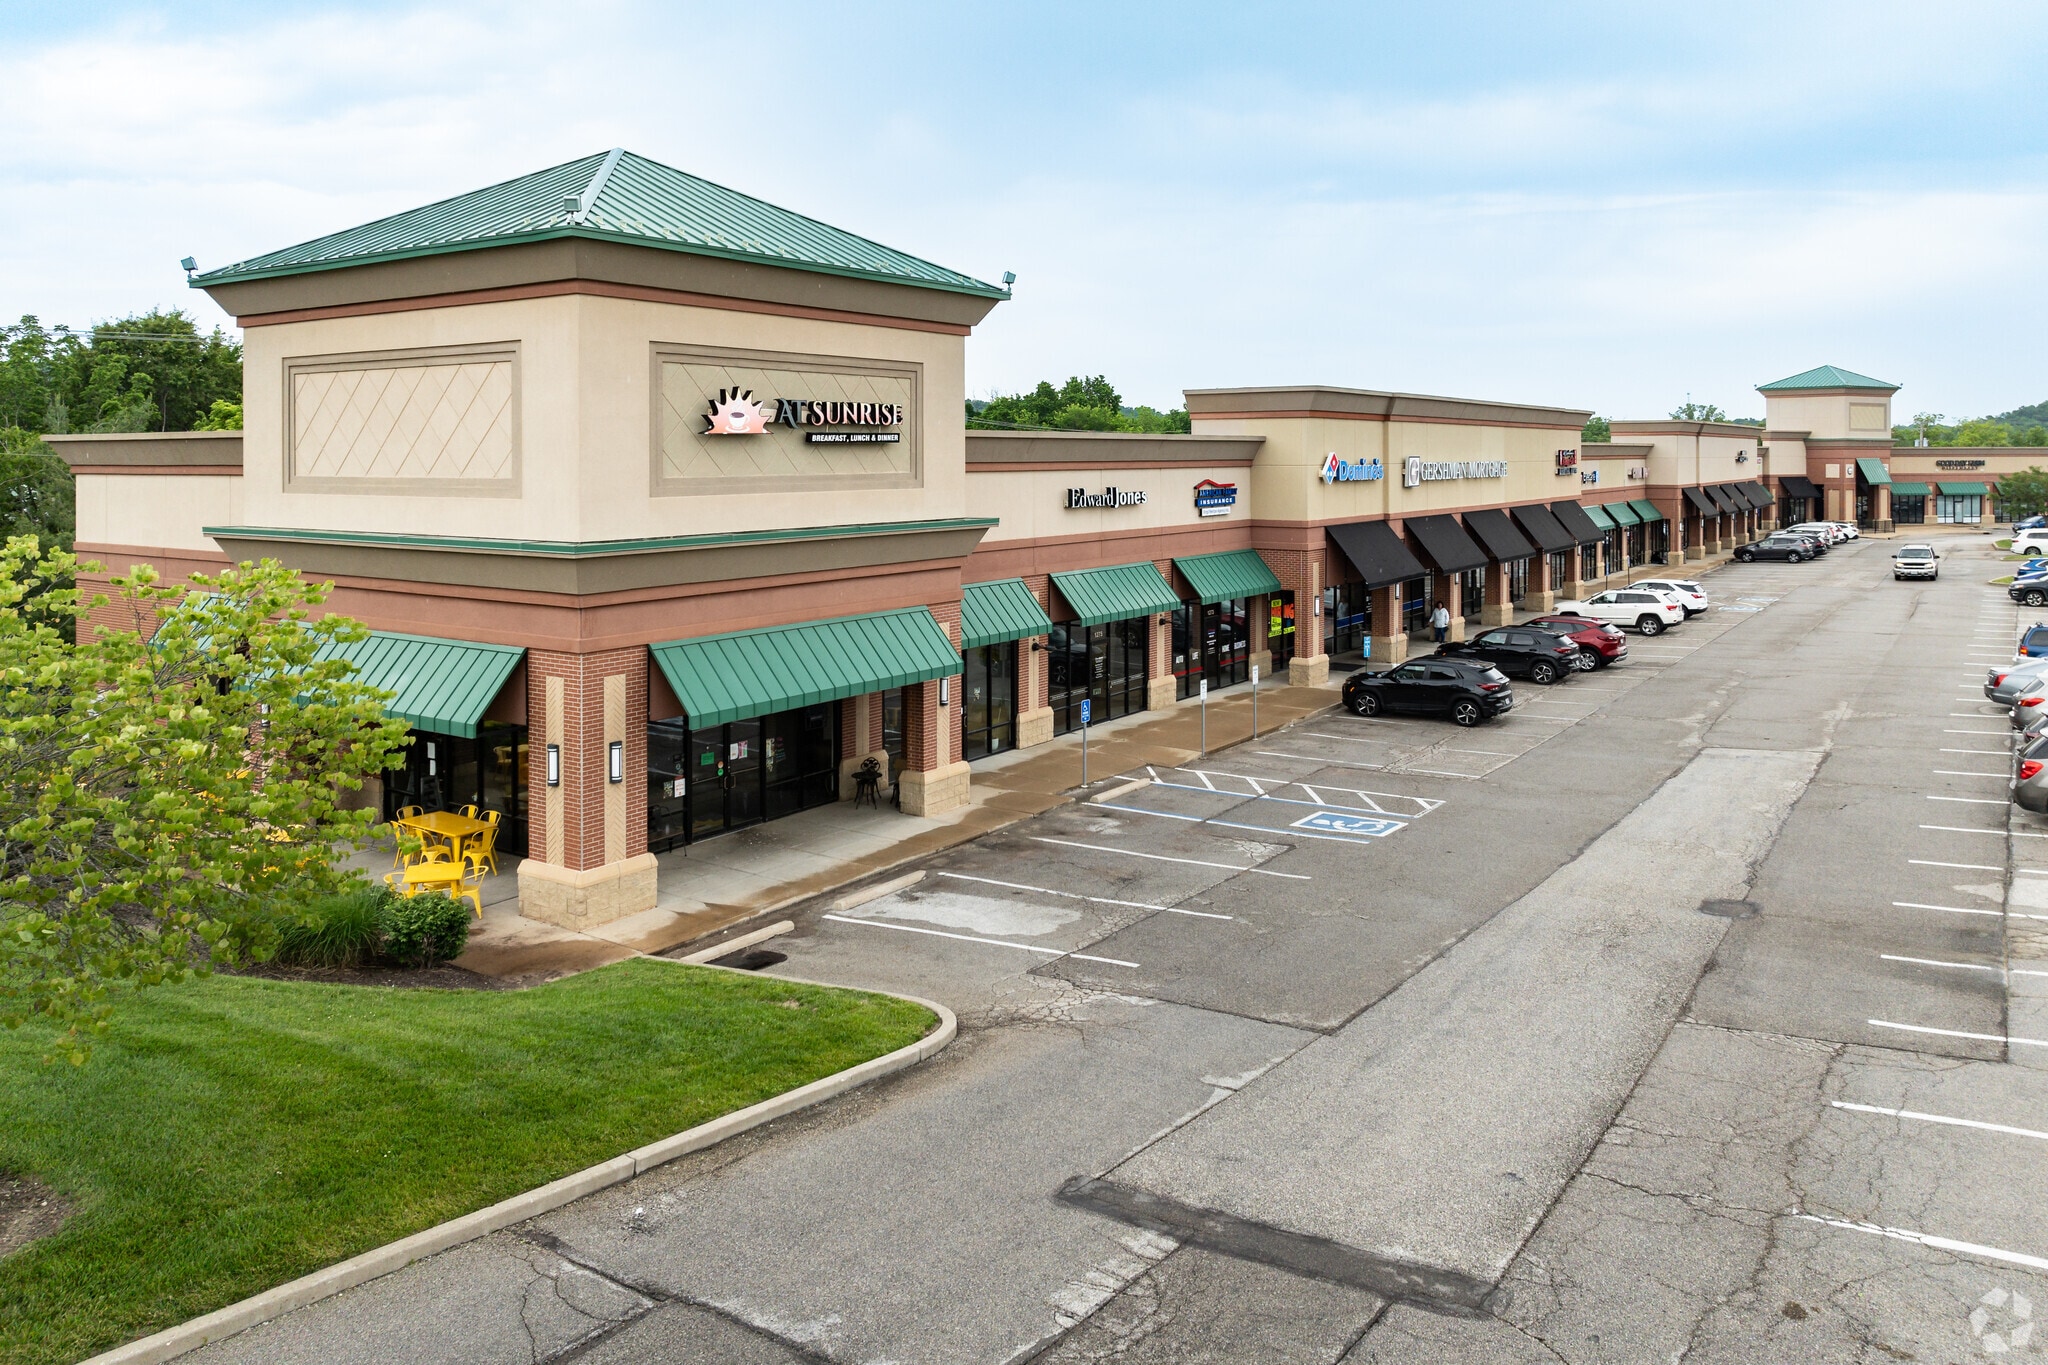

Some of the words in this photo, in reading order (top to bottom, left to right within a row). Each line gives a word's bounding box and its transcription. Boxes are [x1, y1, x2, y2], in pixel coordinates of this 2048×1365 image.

[775, 398, 807, 429] AT
[811, 400, 903, 426] SUNRISE
[811, 434, 850, 442] BREAKFAST,
[877, 433, 899, 441] DINNER
[1421, 462, 1468, 480] GERSHMAN
[1469, 460, 1508, 479] MORTGAGE
[1071, 487, 1114, 508] Edward
[1114, 486, 1148, 508] Jones
[1199, 497, 1233, 505] INSURANCE
